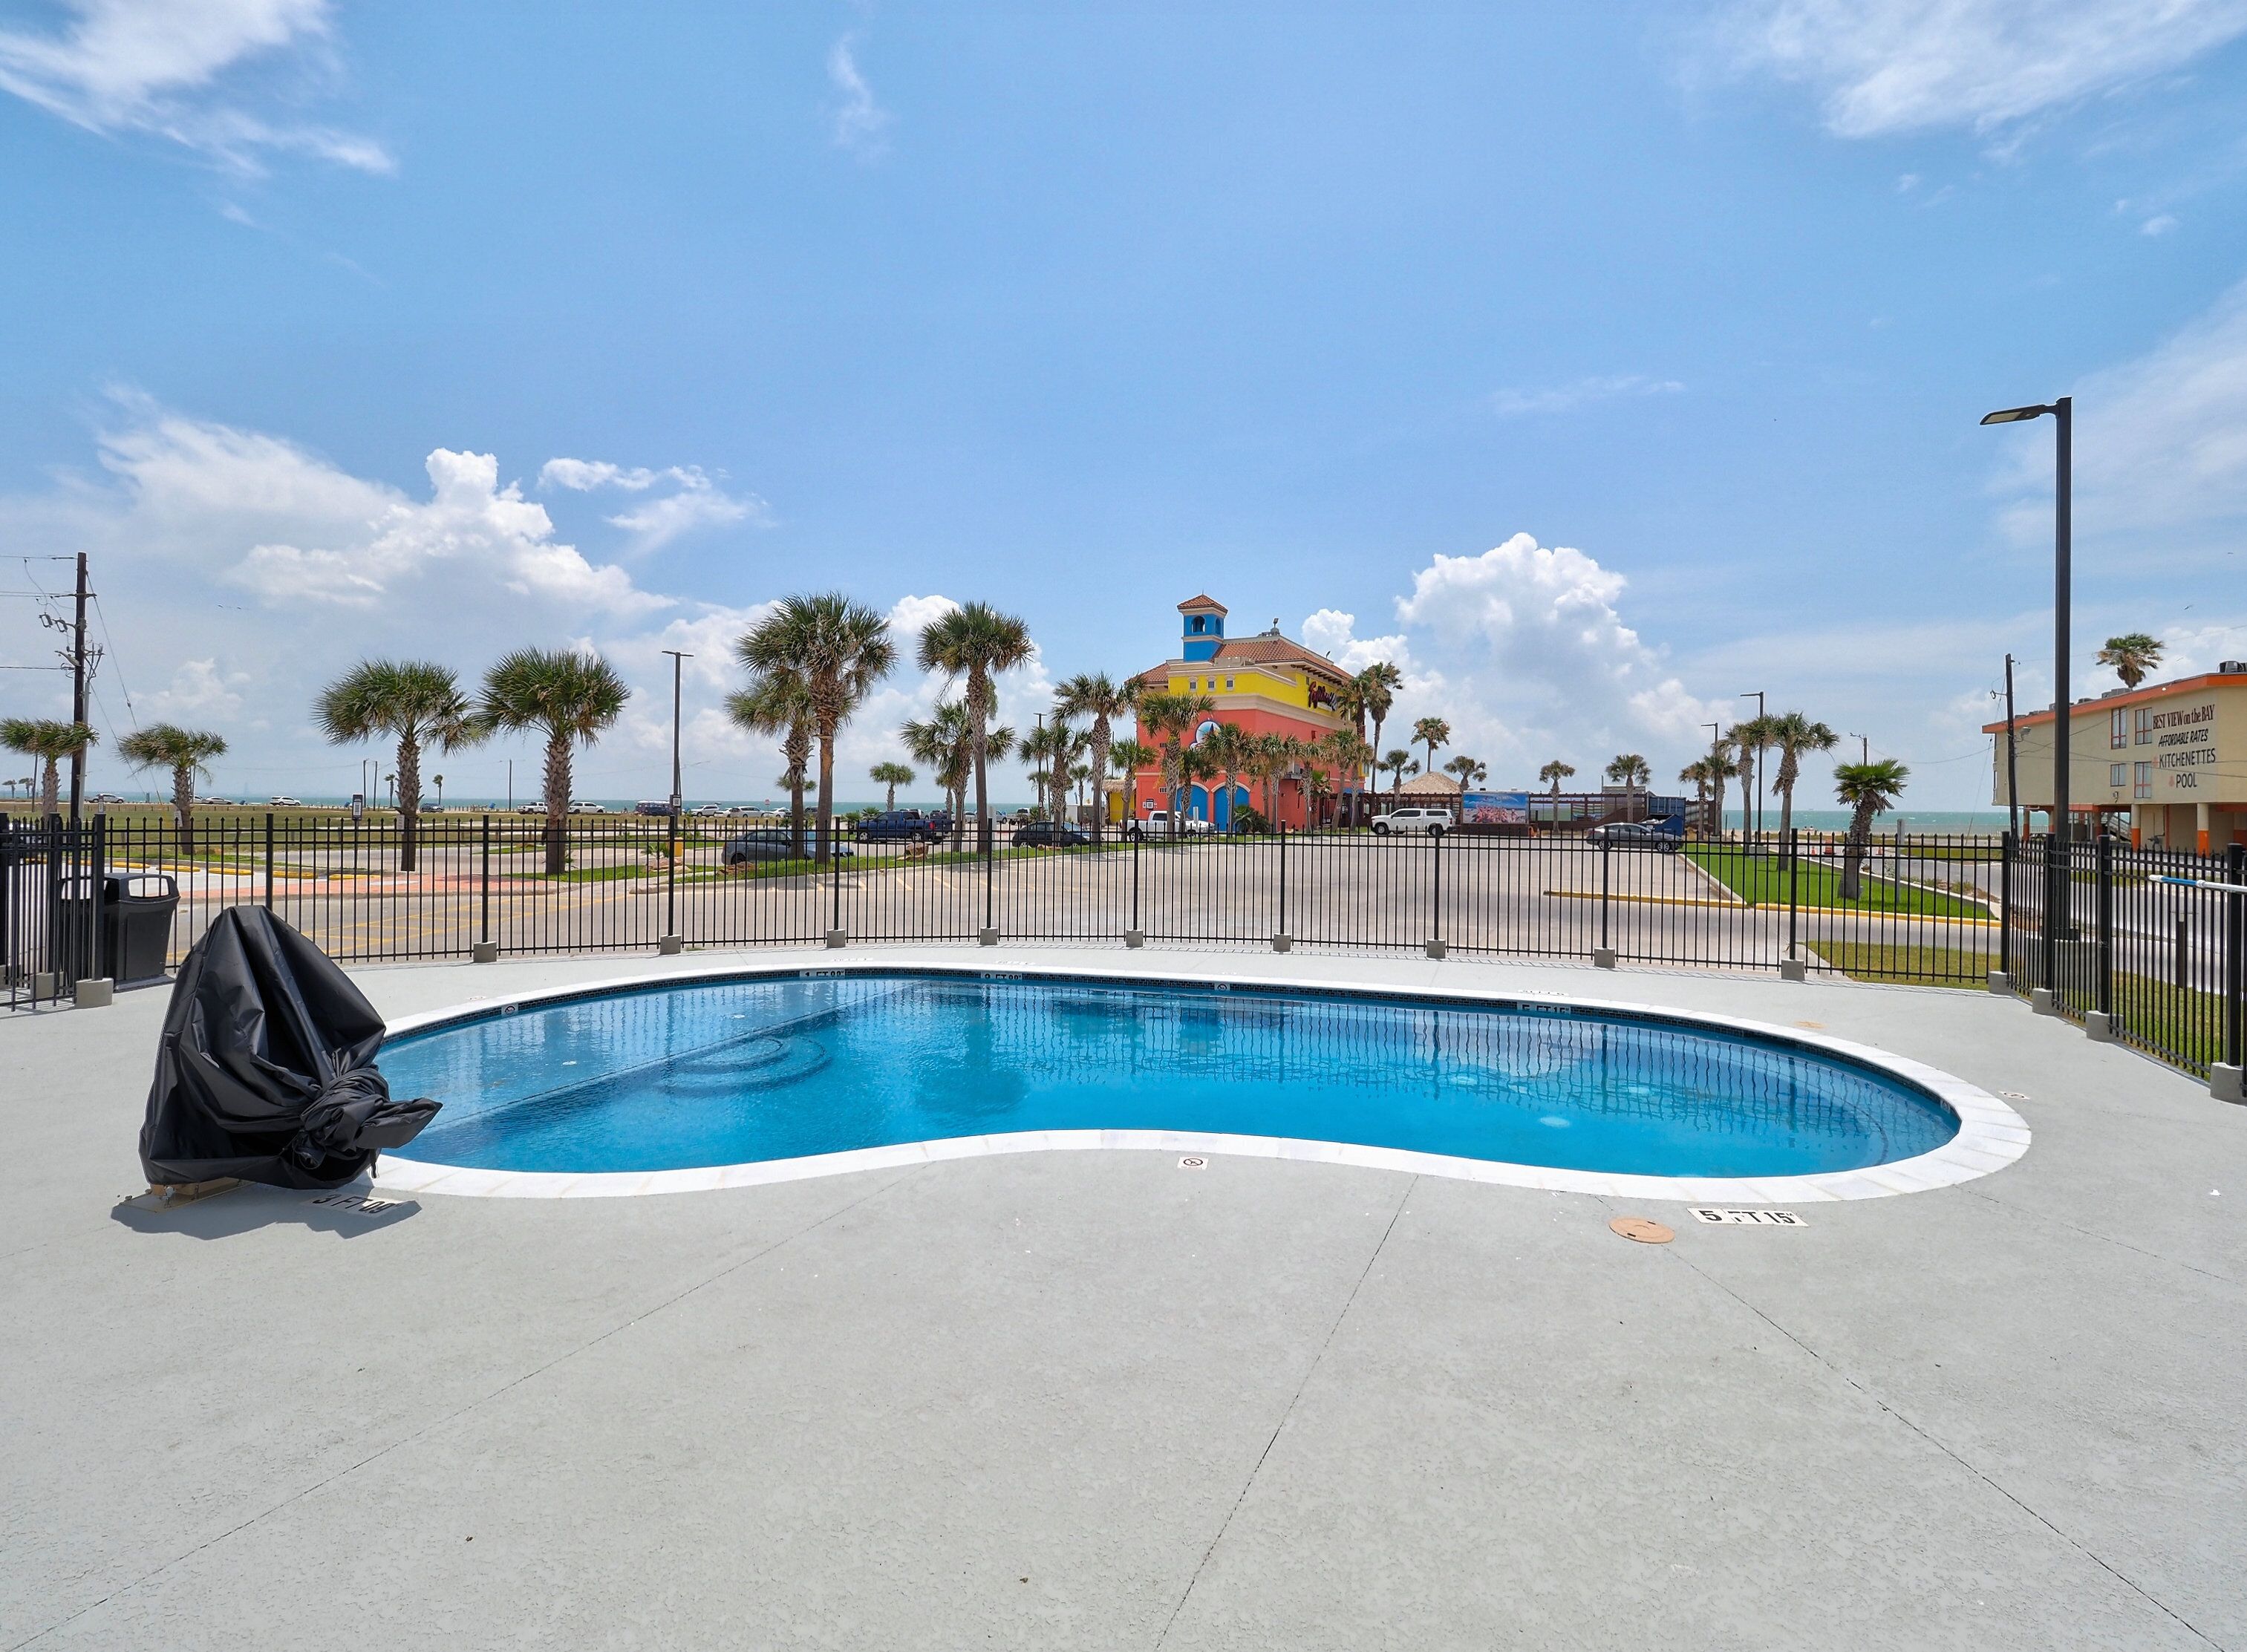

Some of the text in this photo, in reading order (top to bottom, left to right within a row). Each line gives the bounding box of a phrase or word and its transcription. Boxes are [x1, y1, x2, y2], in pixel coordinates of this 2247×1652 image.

[2153, 705, 2215, 729] BEST VIEW on the BAY
[2158, 728, 2208, 747] AFFORDABLE RATES
[2159, 748, 2216, 768] KITCHENETTES
[2176, 772, 2197, 788] POOL
[330, 1195, 374, 1209] FT
[1698, 1209, 1722, 1221] 5
